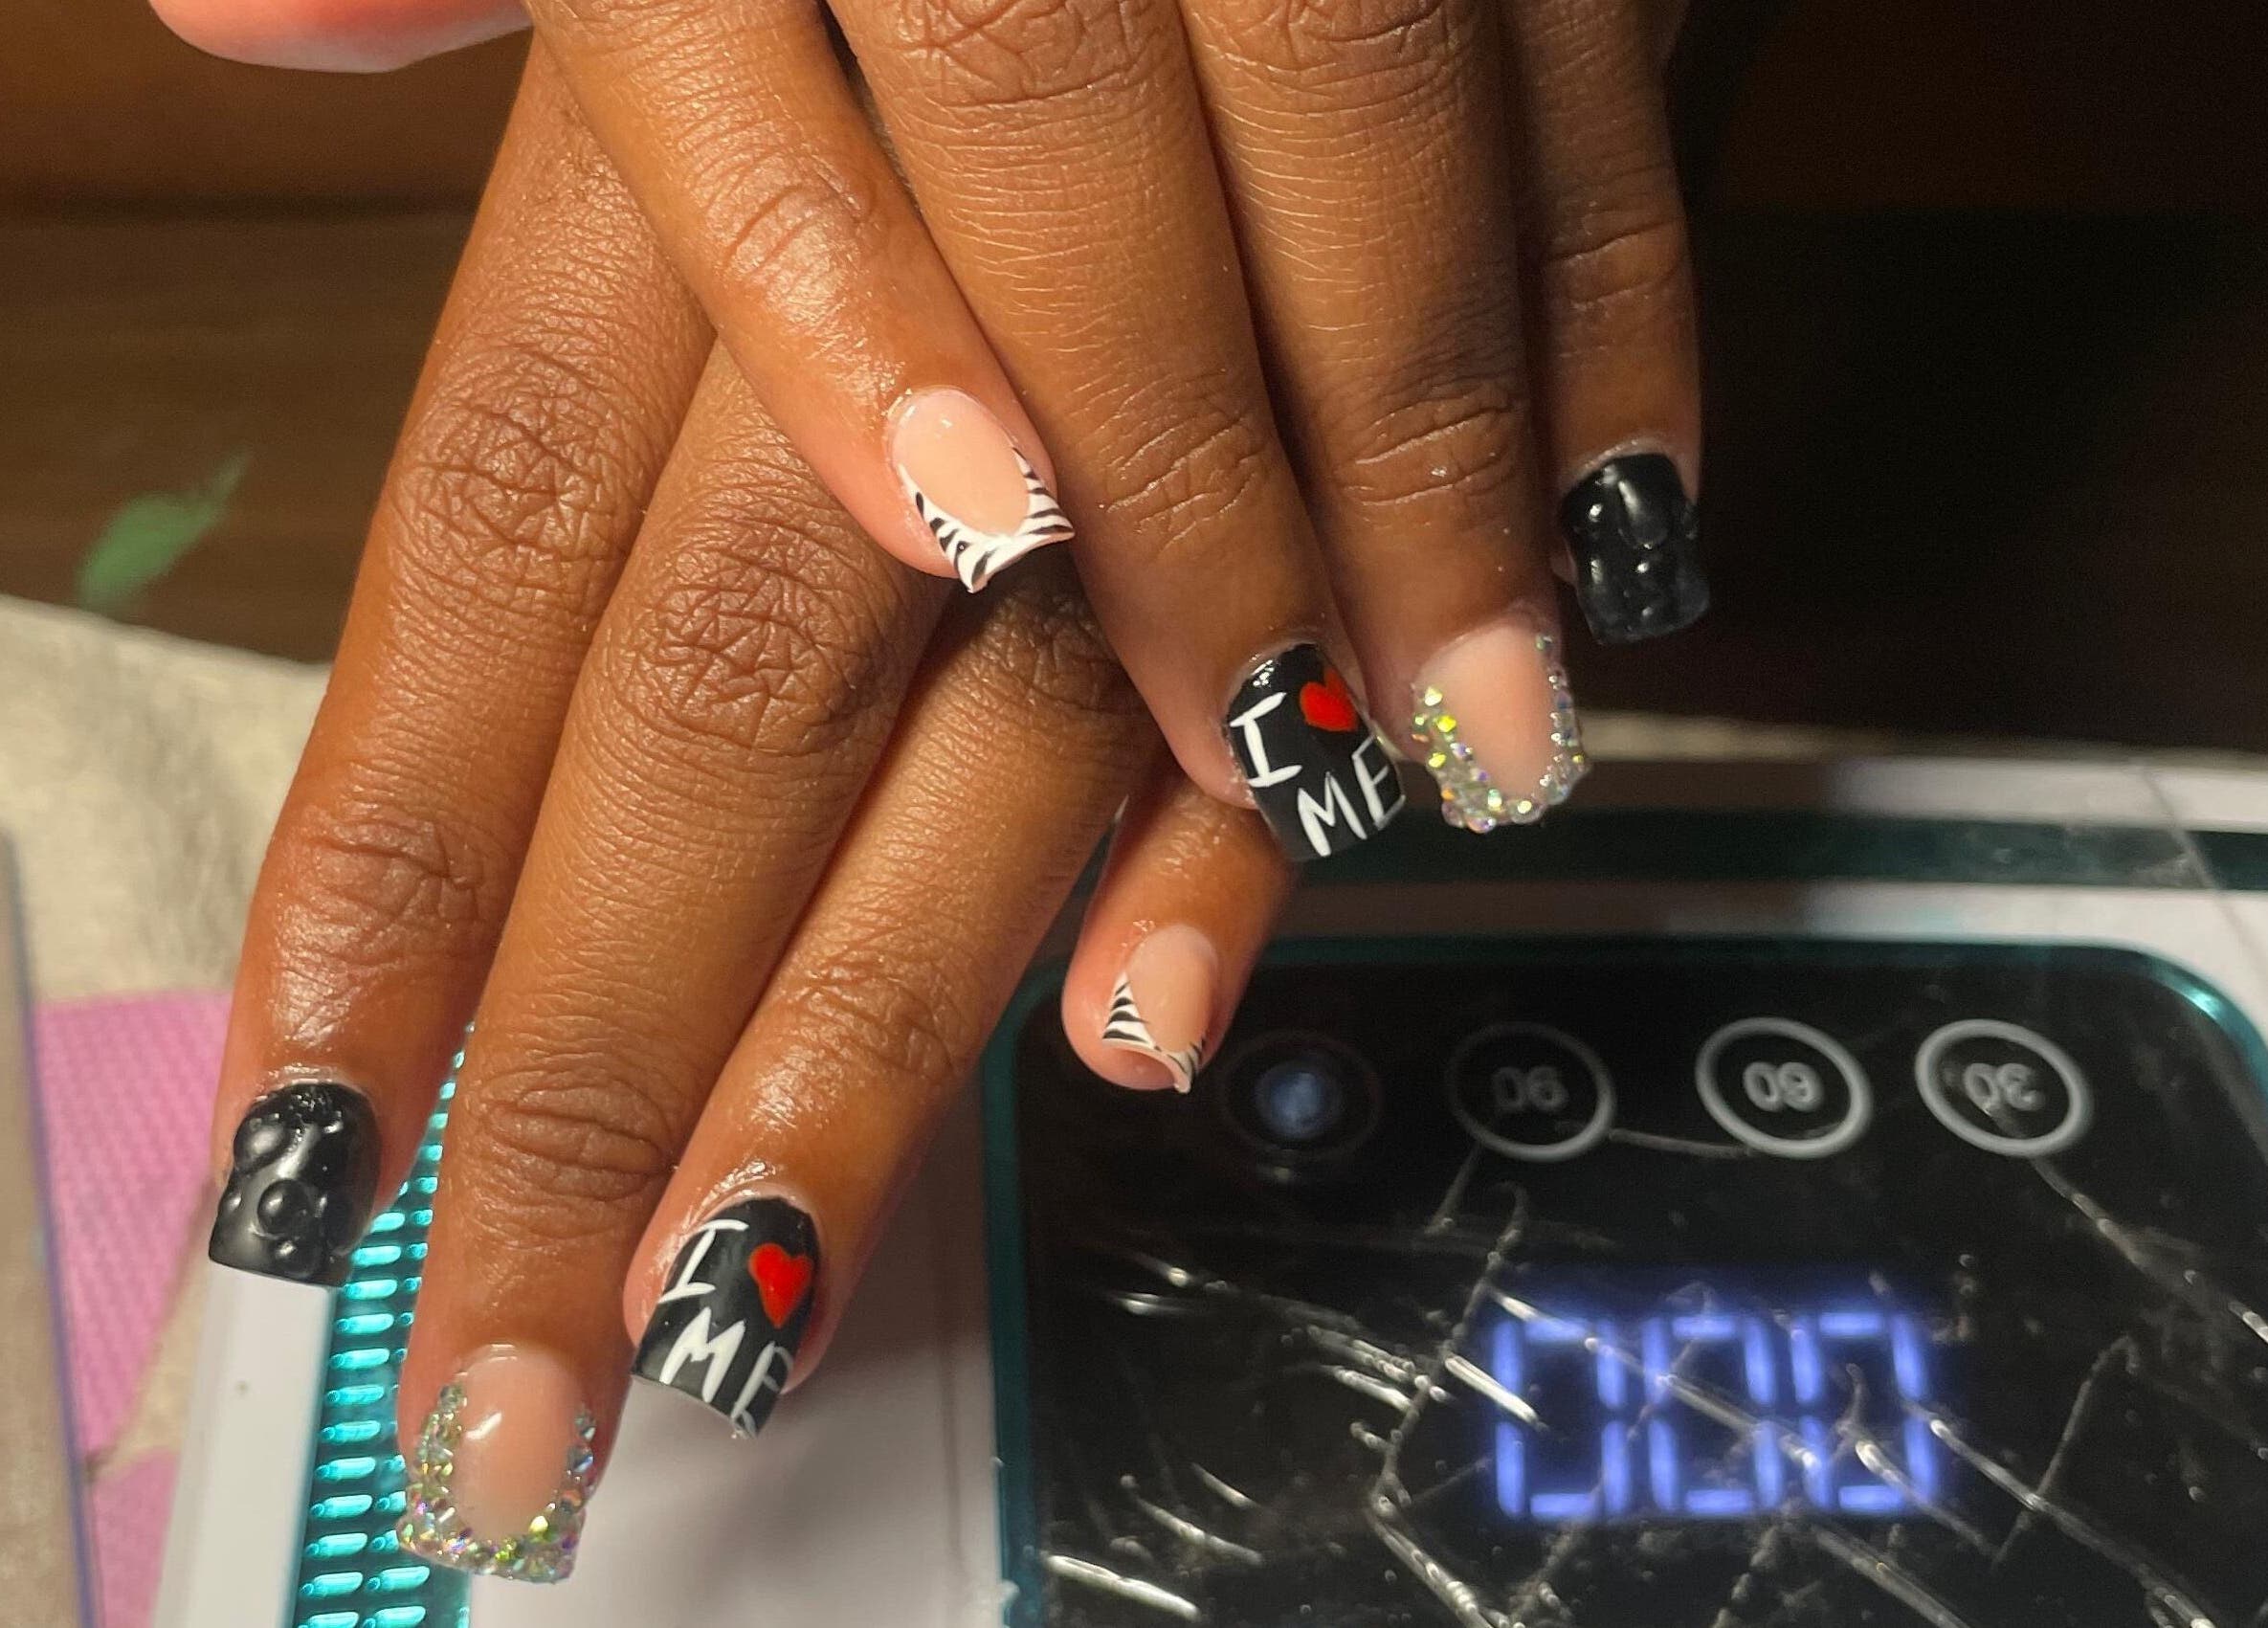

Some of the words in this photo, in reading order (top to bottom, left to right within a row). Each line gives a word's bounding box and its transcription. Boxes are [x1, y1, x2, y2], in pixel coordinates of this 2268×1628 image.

[1230, 691, 1302, 788] I
[1298, 734, 1406, 858] ME
[657, 1218, 749, 1305] I
[658, 1305, 793, 1438] ME
[1490, 1311, 1940, 1523] 000
